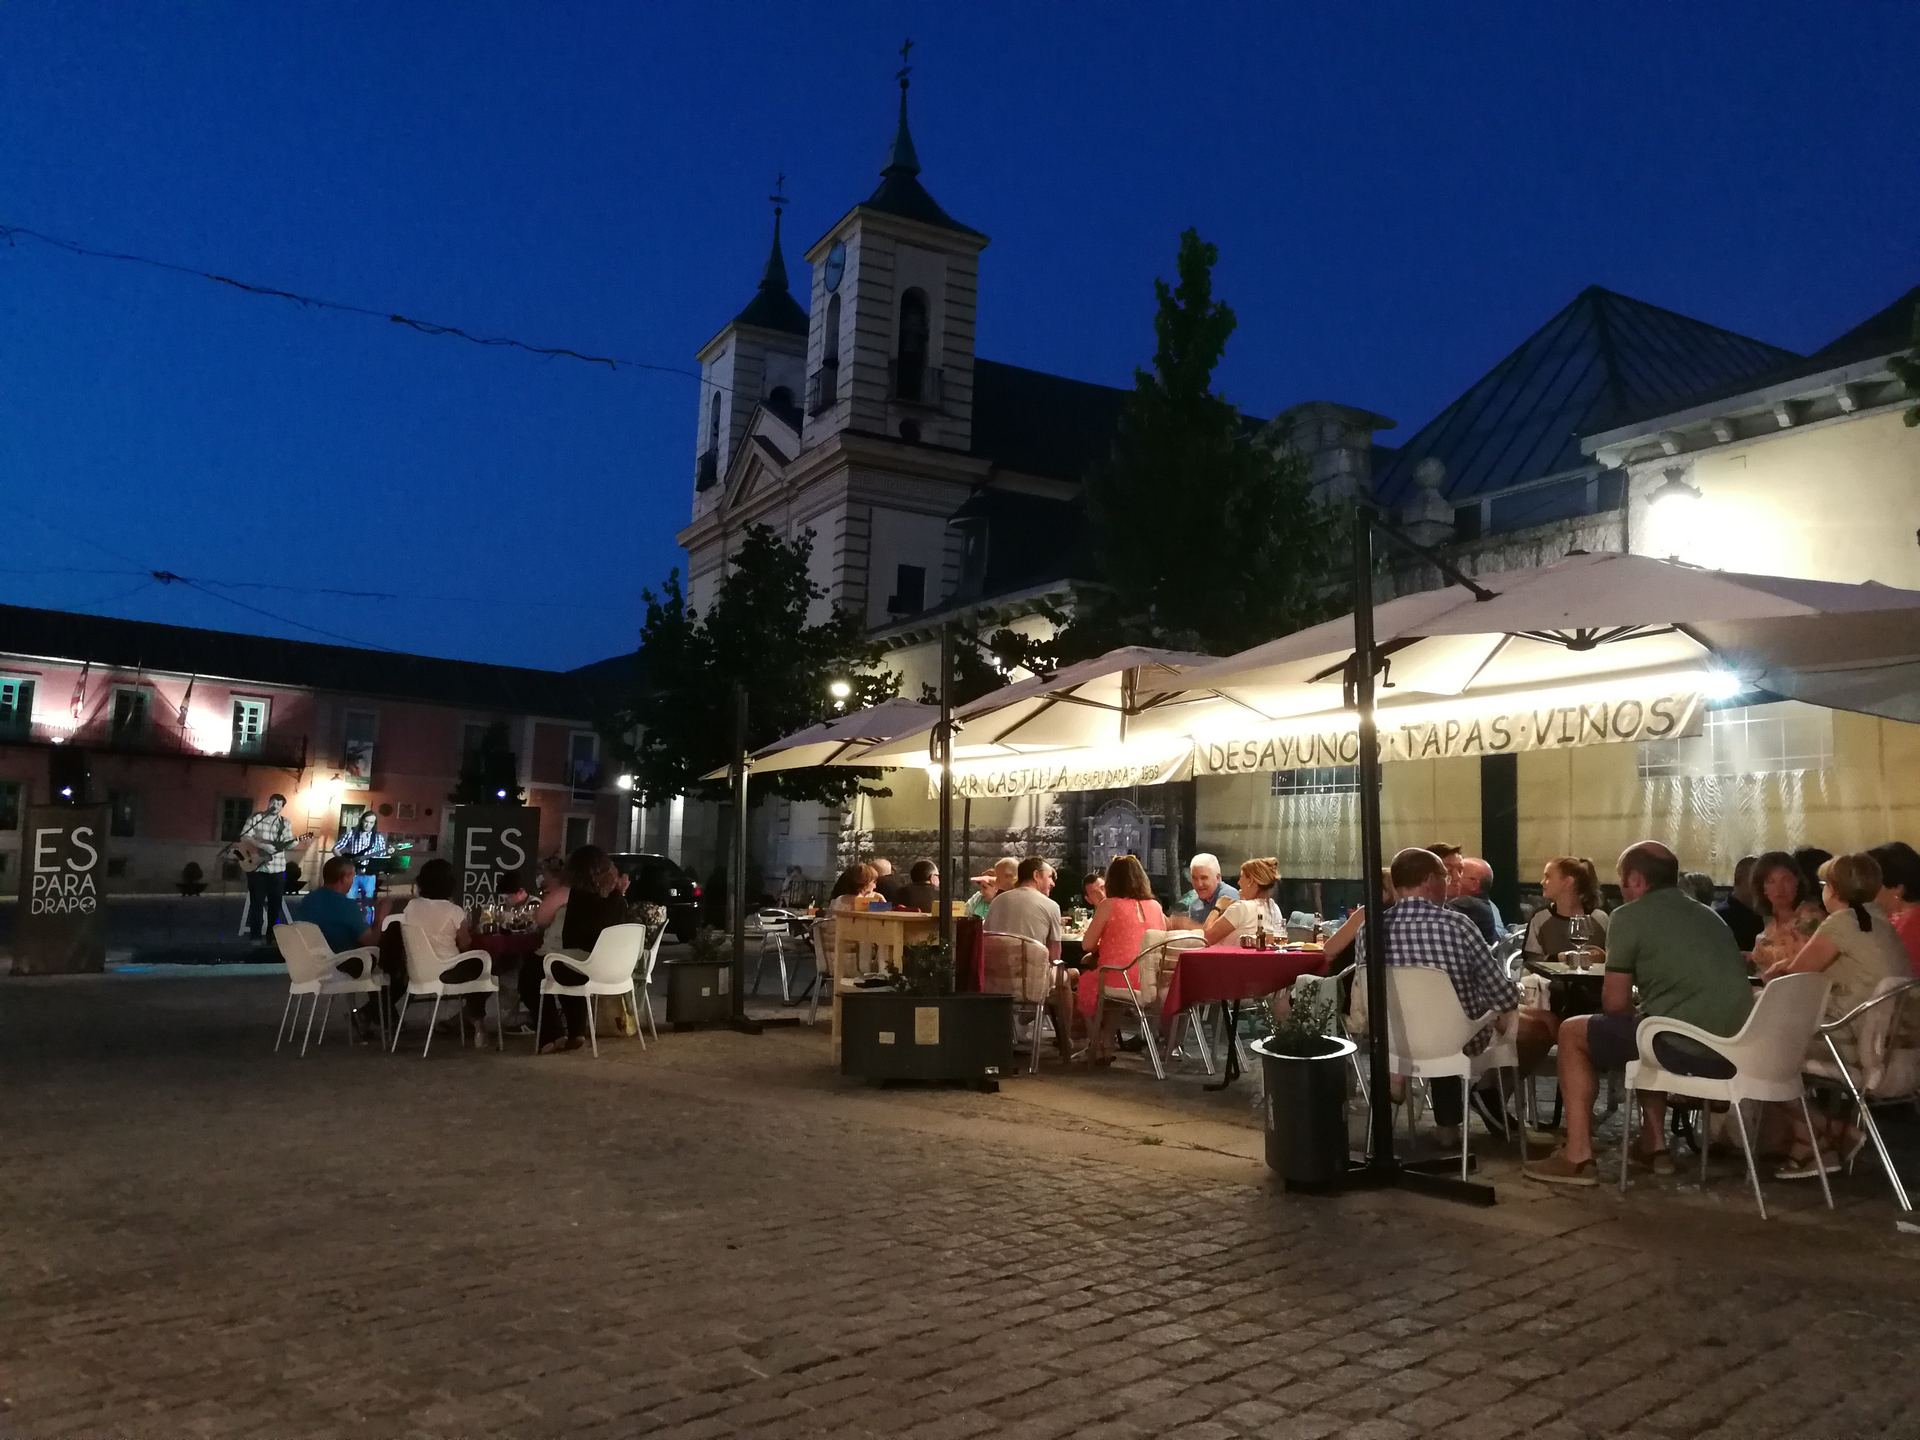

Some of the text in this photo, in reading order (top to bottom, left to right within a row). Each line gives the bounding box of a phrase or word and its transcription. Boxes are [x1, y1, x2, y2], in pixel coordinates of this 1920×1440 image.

[1208, 697, 1676, 772] DESAYUNO TAPAS VINOS
[951, 773, 978, 796] BAR
[986, 765, 1068, 794] CASTILLA
[1141, 764, 1160, 781] 1959
[34, 826, 98, 873] ES
[465, 827, 526, 871] ES
[32, 873, 97, 897] PARA
